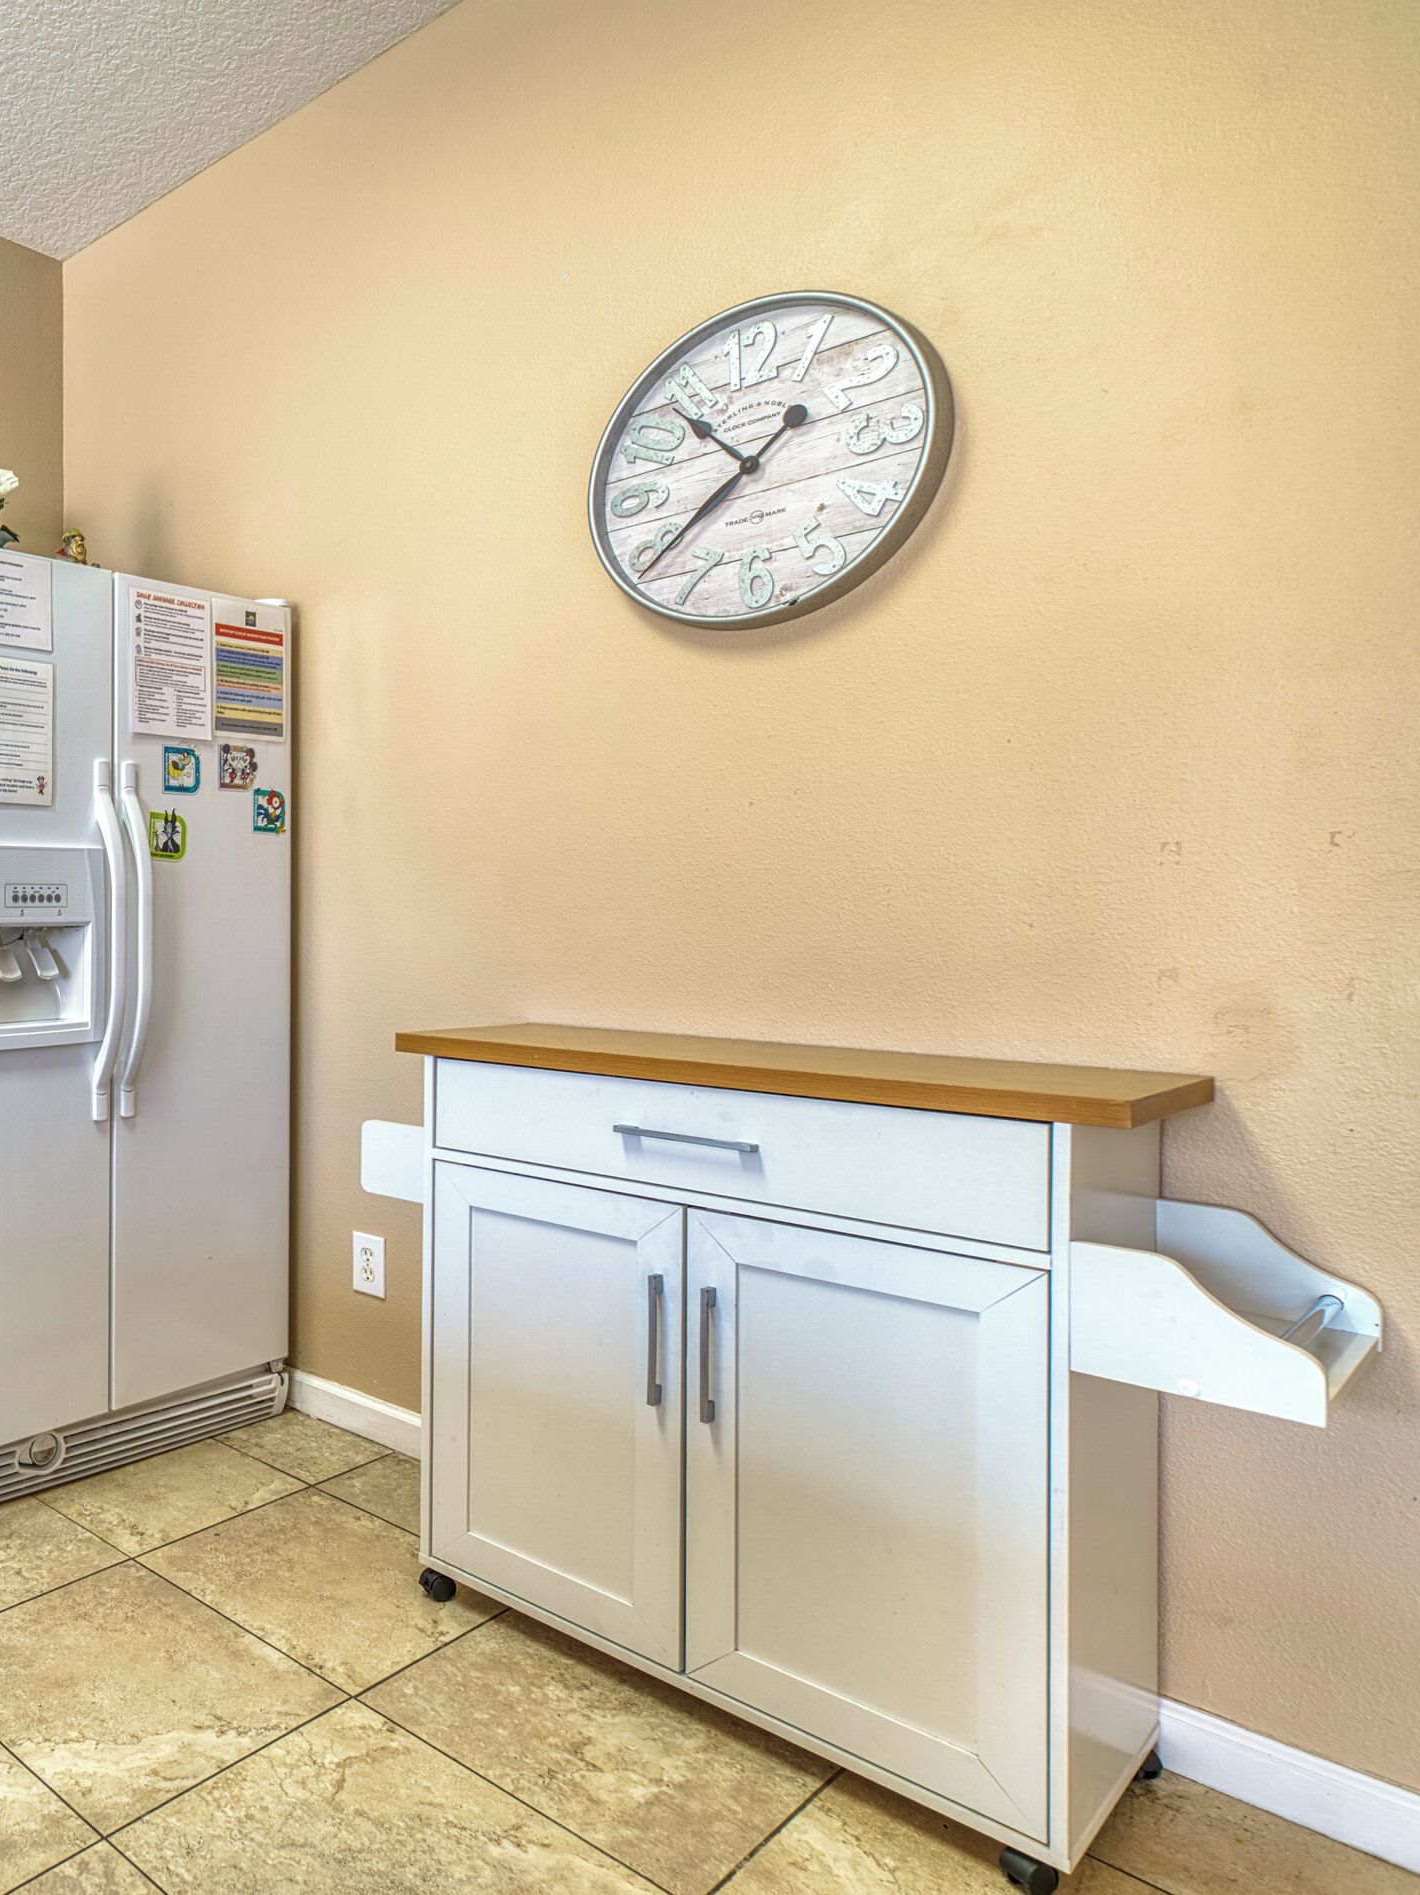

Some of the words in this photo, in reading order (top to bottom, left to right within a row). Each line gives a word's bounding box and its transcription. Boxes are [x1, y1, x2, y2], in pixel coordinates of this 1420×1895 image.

[722, 320, 779, 392] 12
[792, 314, 834, 383] 1
[663, 361, 719, 420] 11
[822, 344, 899, 412] 2
[620, 416, 686, 466] 10
[712, 402, 754, 434] STERLING
[723, 423, 746, 433] CLOCK
[747, 410, 781, 425] COMPANY
[845, 402, 925, 456] 3
[610, 480, 670, 518] 9
[724, 517, 749, 528] TRADE
[765, 507, 787, 517] MARK
[836, 478, 906, 517] 4
[628, 522, 684, 572] 8
[791, 516, 847, 576] 5
[675, 545, 725, 606] 7
[738, 547, 775, 609] 6
